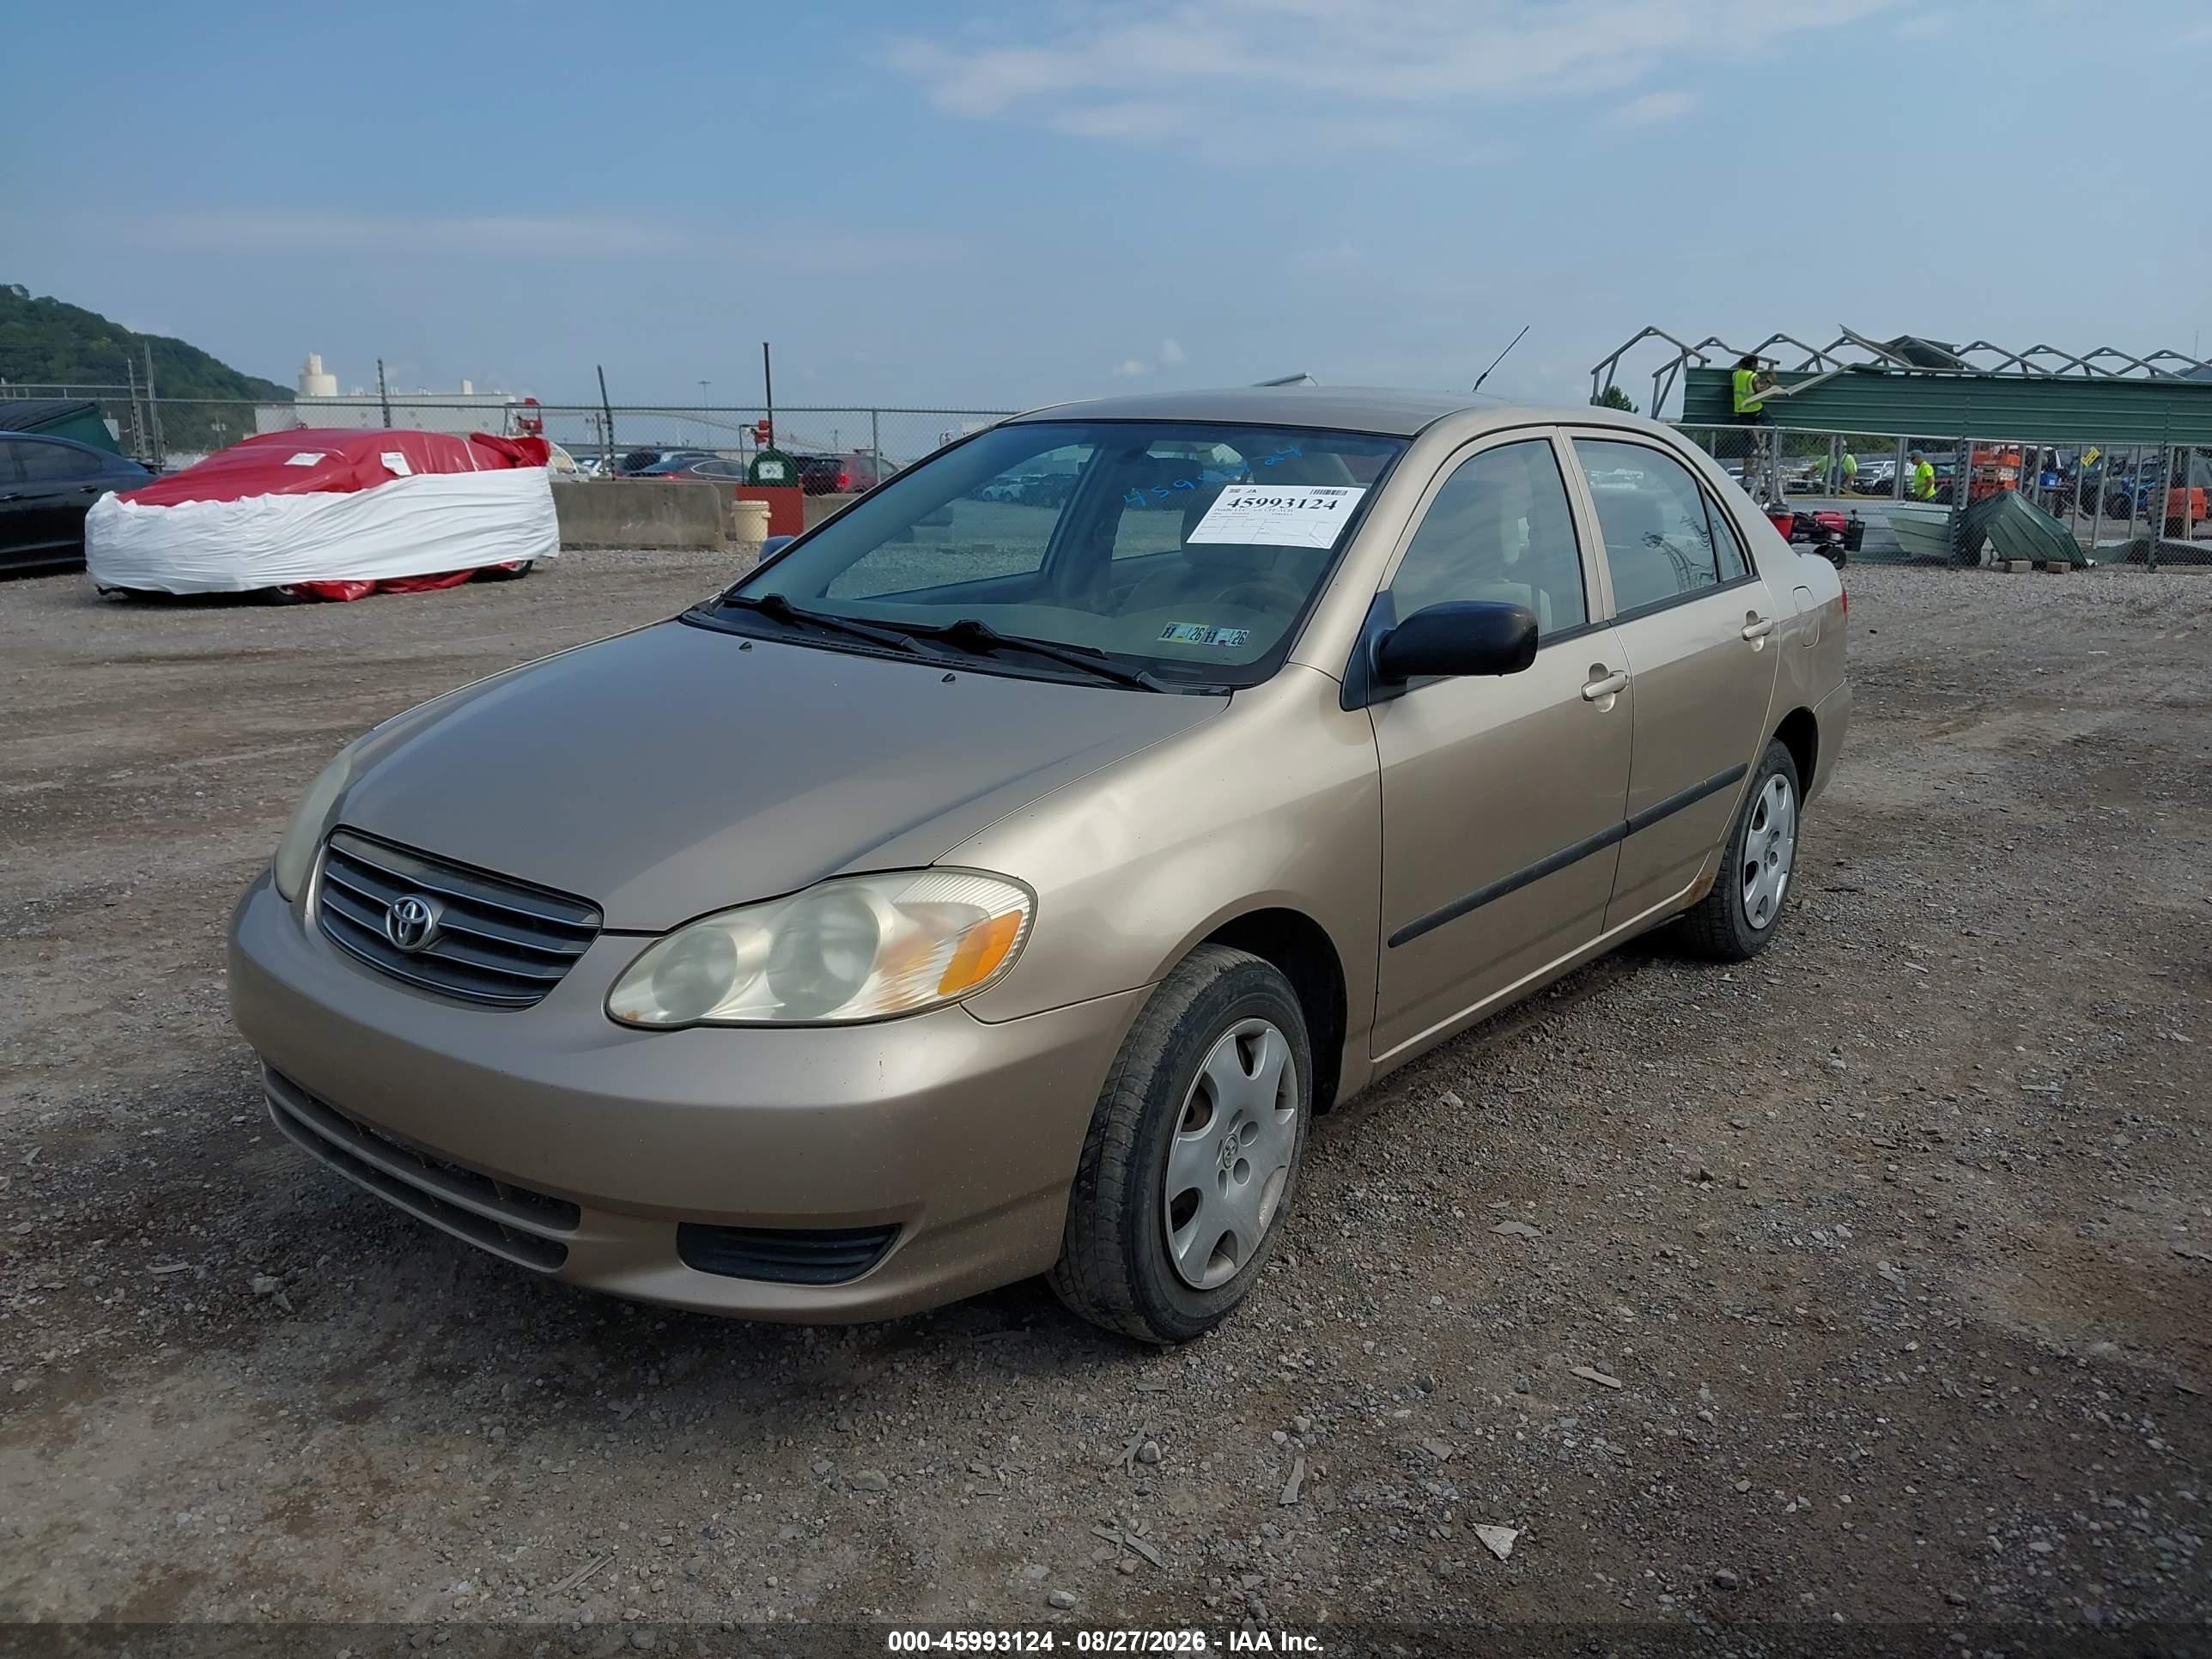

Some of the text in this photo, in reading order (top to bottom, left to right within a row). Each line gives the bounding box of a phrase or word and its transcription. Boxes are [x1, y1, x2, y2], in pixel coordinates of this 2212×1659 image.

[1226, 497, 1339, 510] 45993124
[1189, 627, 1205, 641] 26
[1231, 631, 1247, 645] 26
